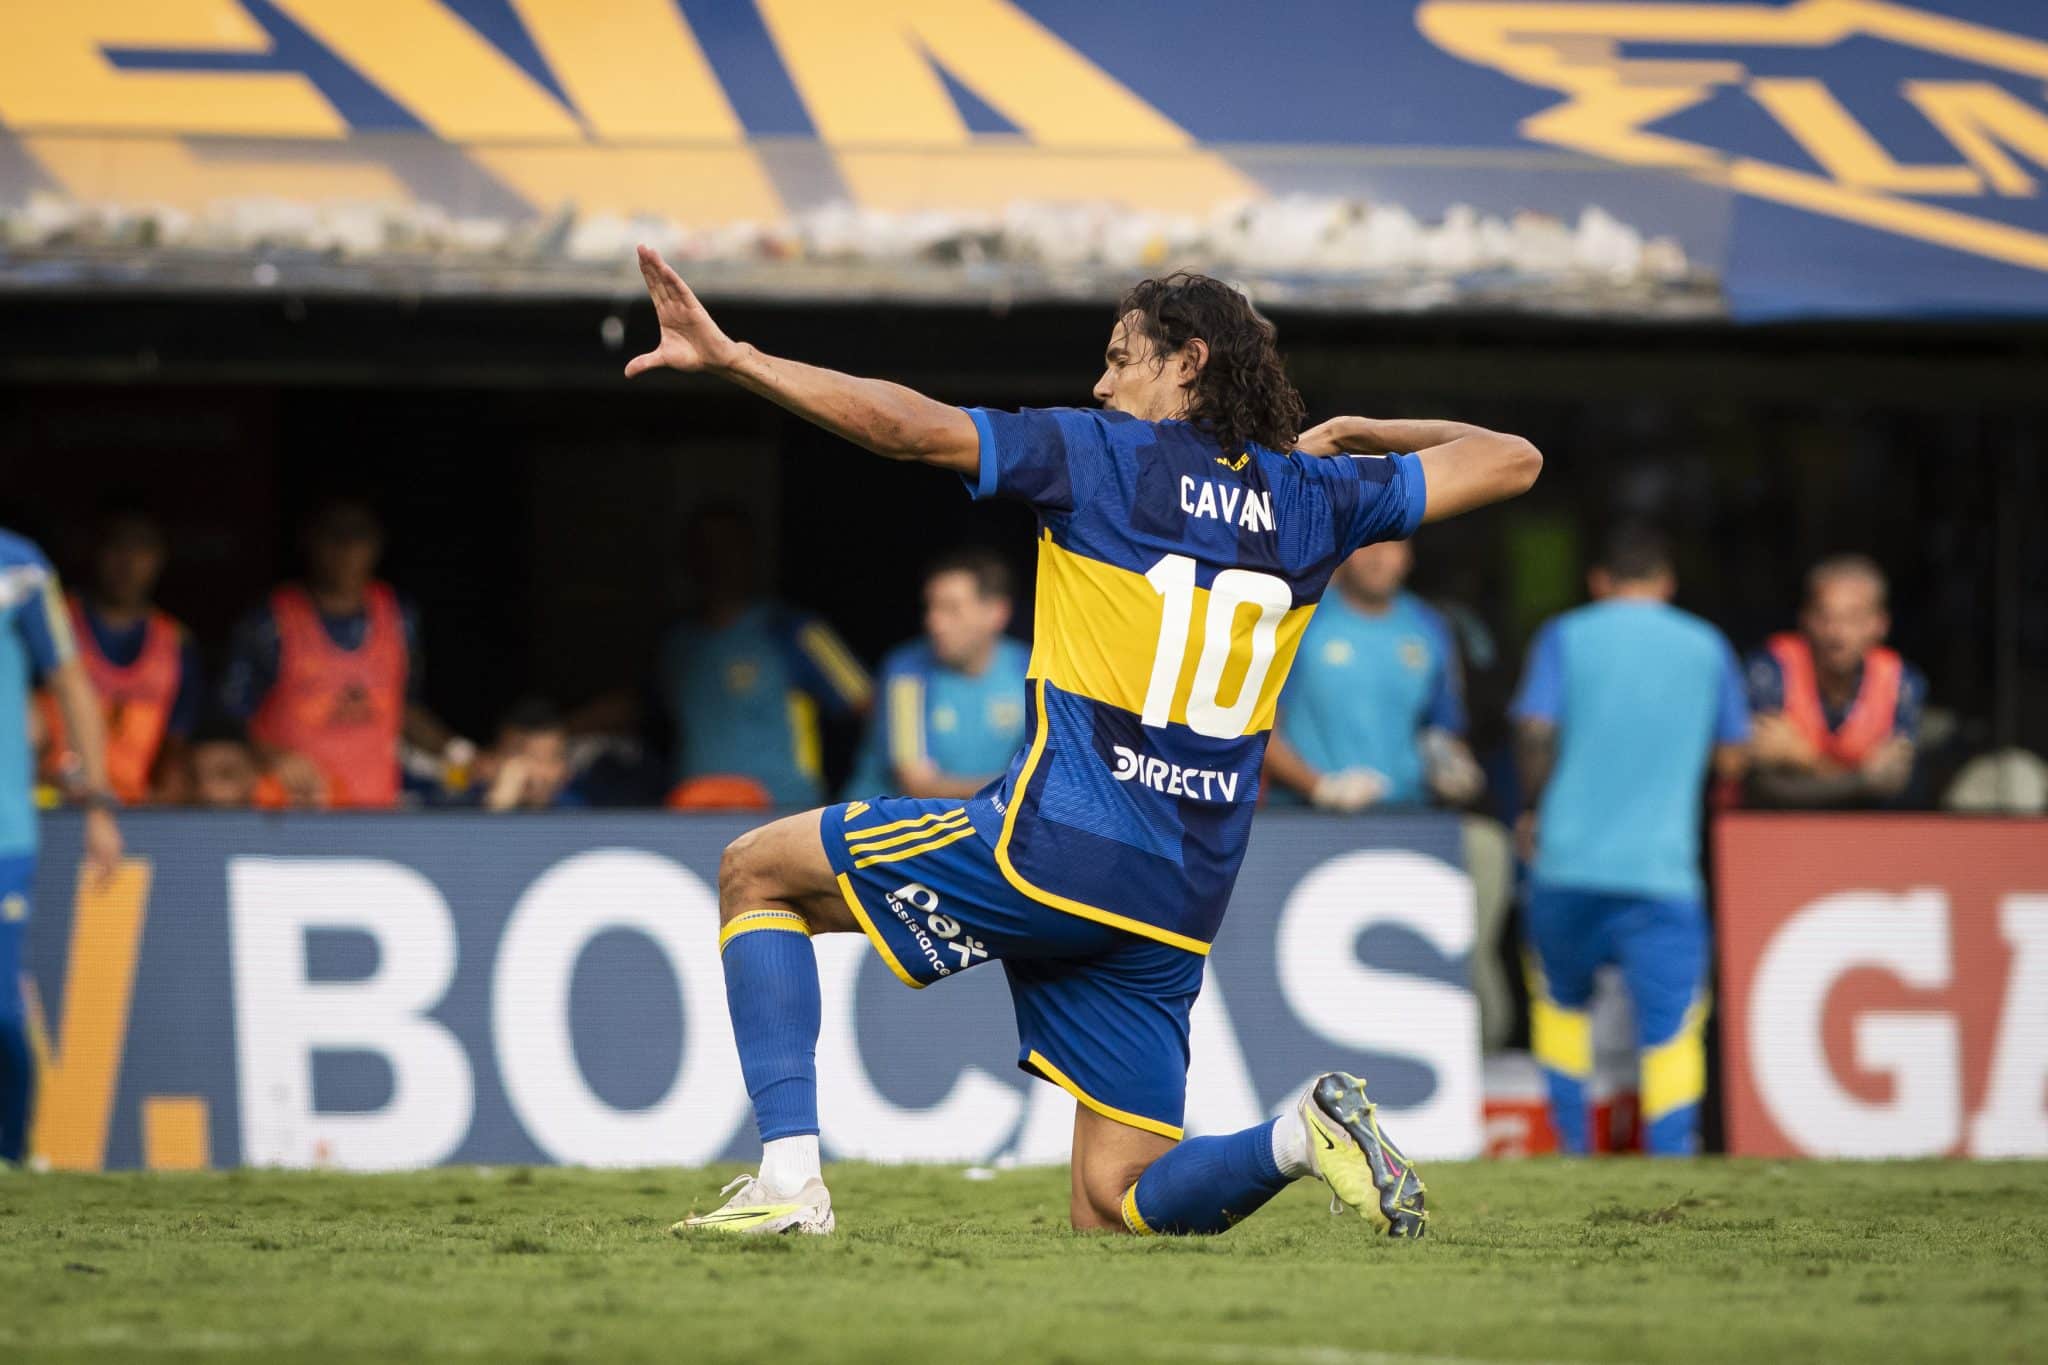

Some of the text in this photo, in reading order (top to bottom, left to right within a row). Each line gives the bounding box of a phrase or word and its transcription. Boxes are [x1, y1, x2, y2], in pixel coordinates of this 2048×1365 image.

[1181, 475, 1276, 533] CAVAN
[1141, 553, 1292, 740] 10
[1111, 745, 1239, 802] DIRECTV
[885, 892, 951, 976] assistance
[893, 882, 989, 968] pax
